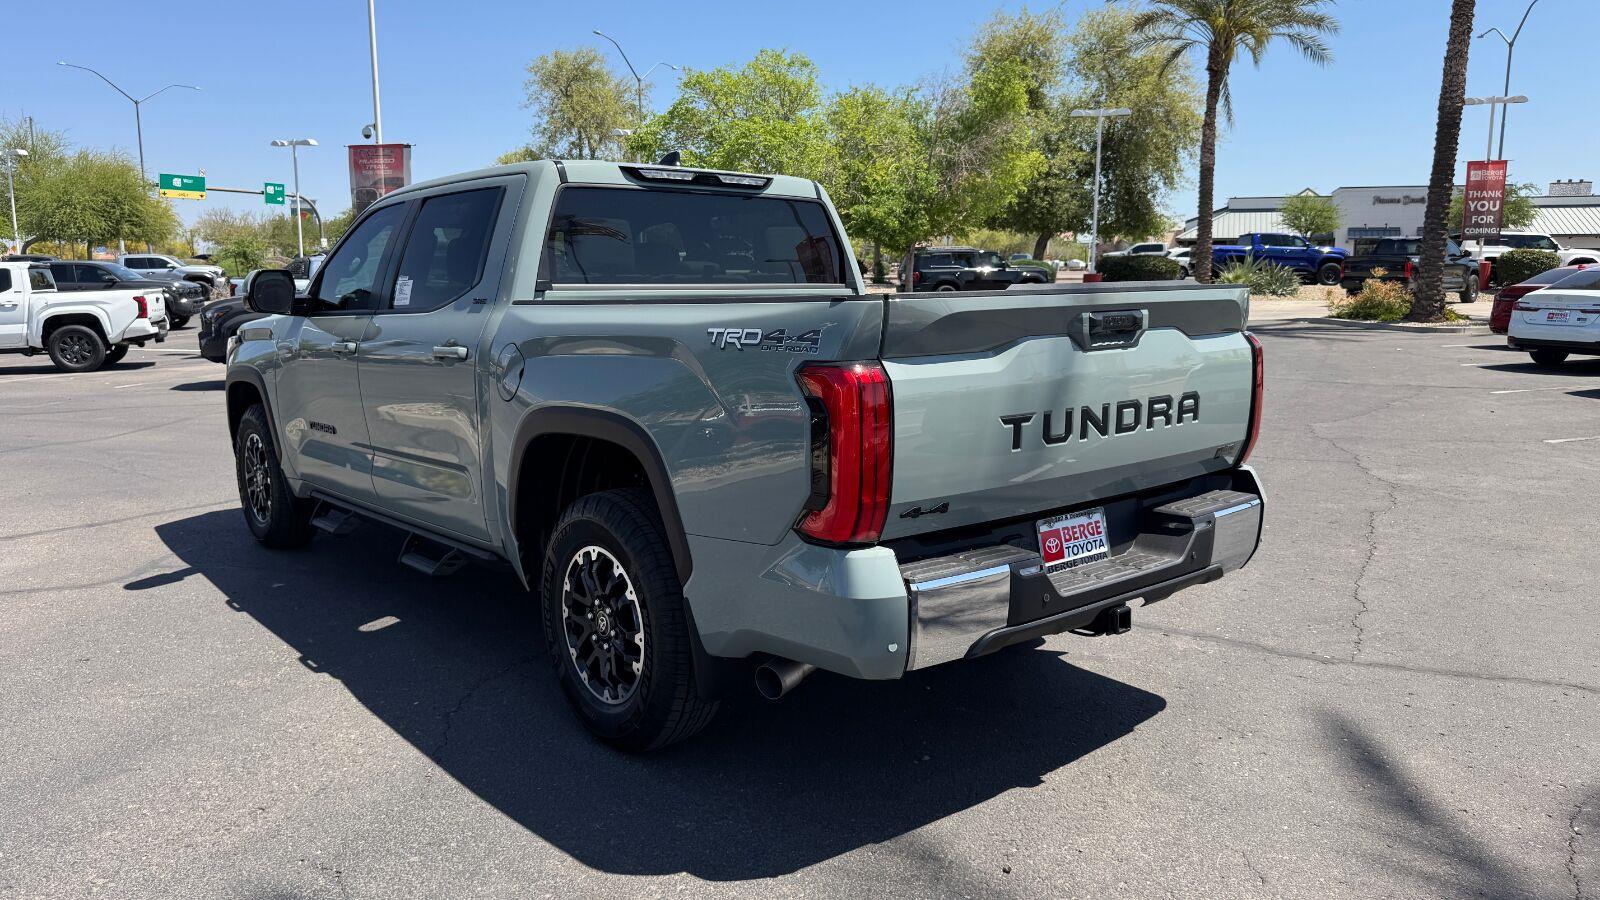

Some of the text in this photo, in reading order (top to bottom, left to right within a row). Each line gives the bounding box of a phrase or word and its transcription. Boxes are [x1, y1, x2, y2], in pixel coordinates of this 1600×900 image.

[1468, 190, 1503, 198] THANK
[1468, 200, 1500, 212] YOU
[1471, 215, 1494, 224] FOR
[707, 328, 763, 351] TRD
[998, 390, 1201, 453] TUNDRA
[1061, 520, 1103, 543] BERGE
[1065, 538, 1106, 557] TOYOTA
[1080, 551, 1108, 566] TOYOTA
[1047, 559, 1079, 574] BERGE
